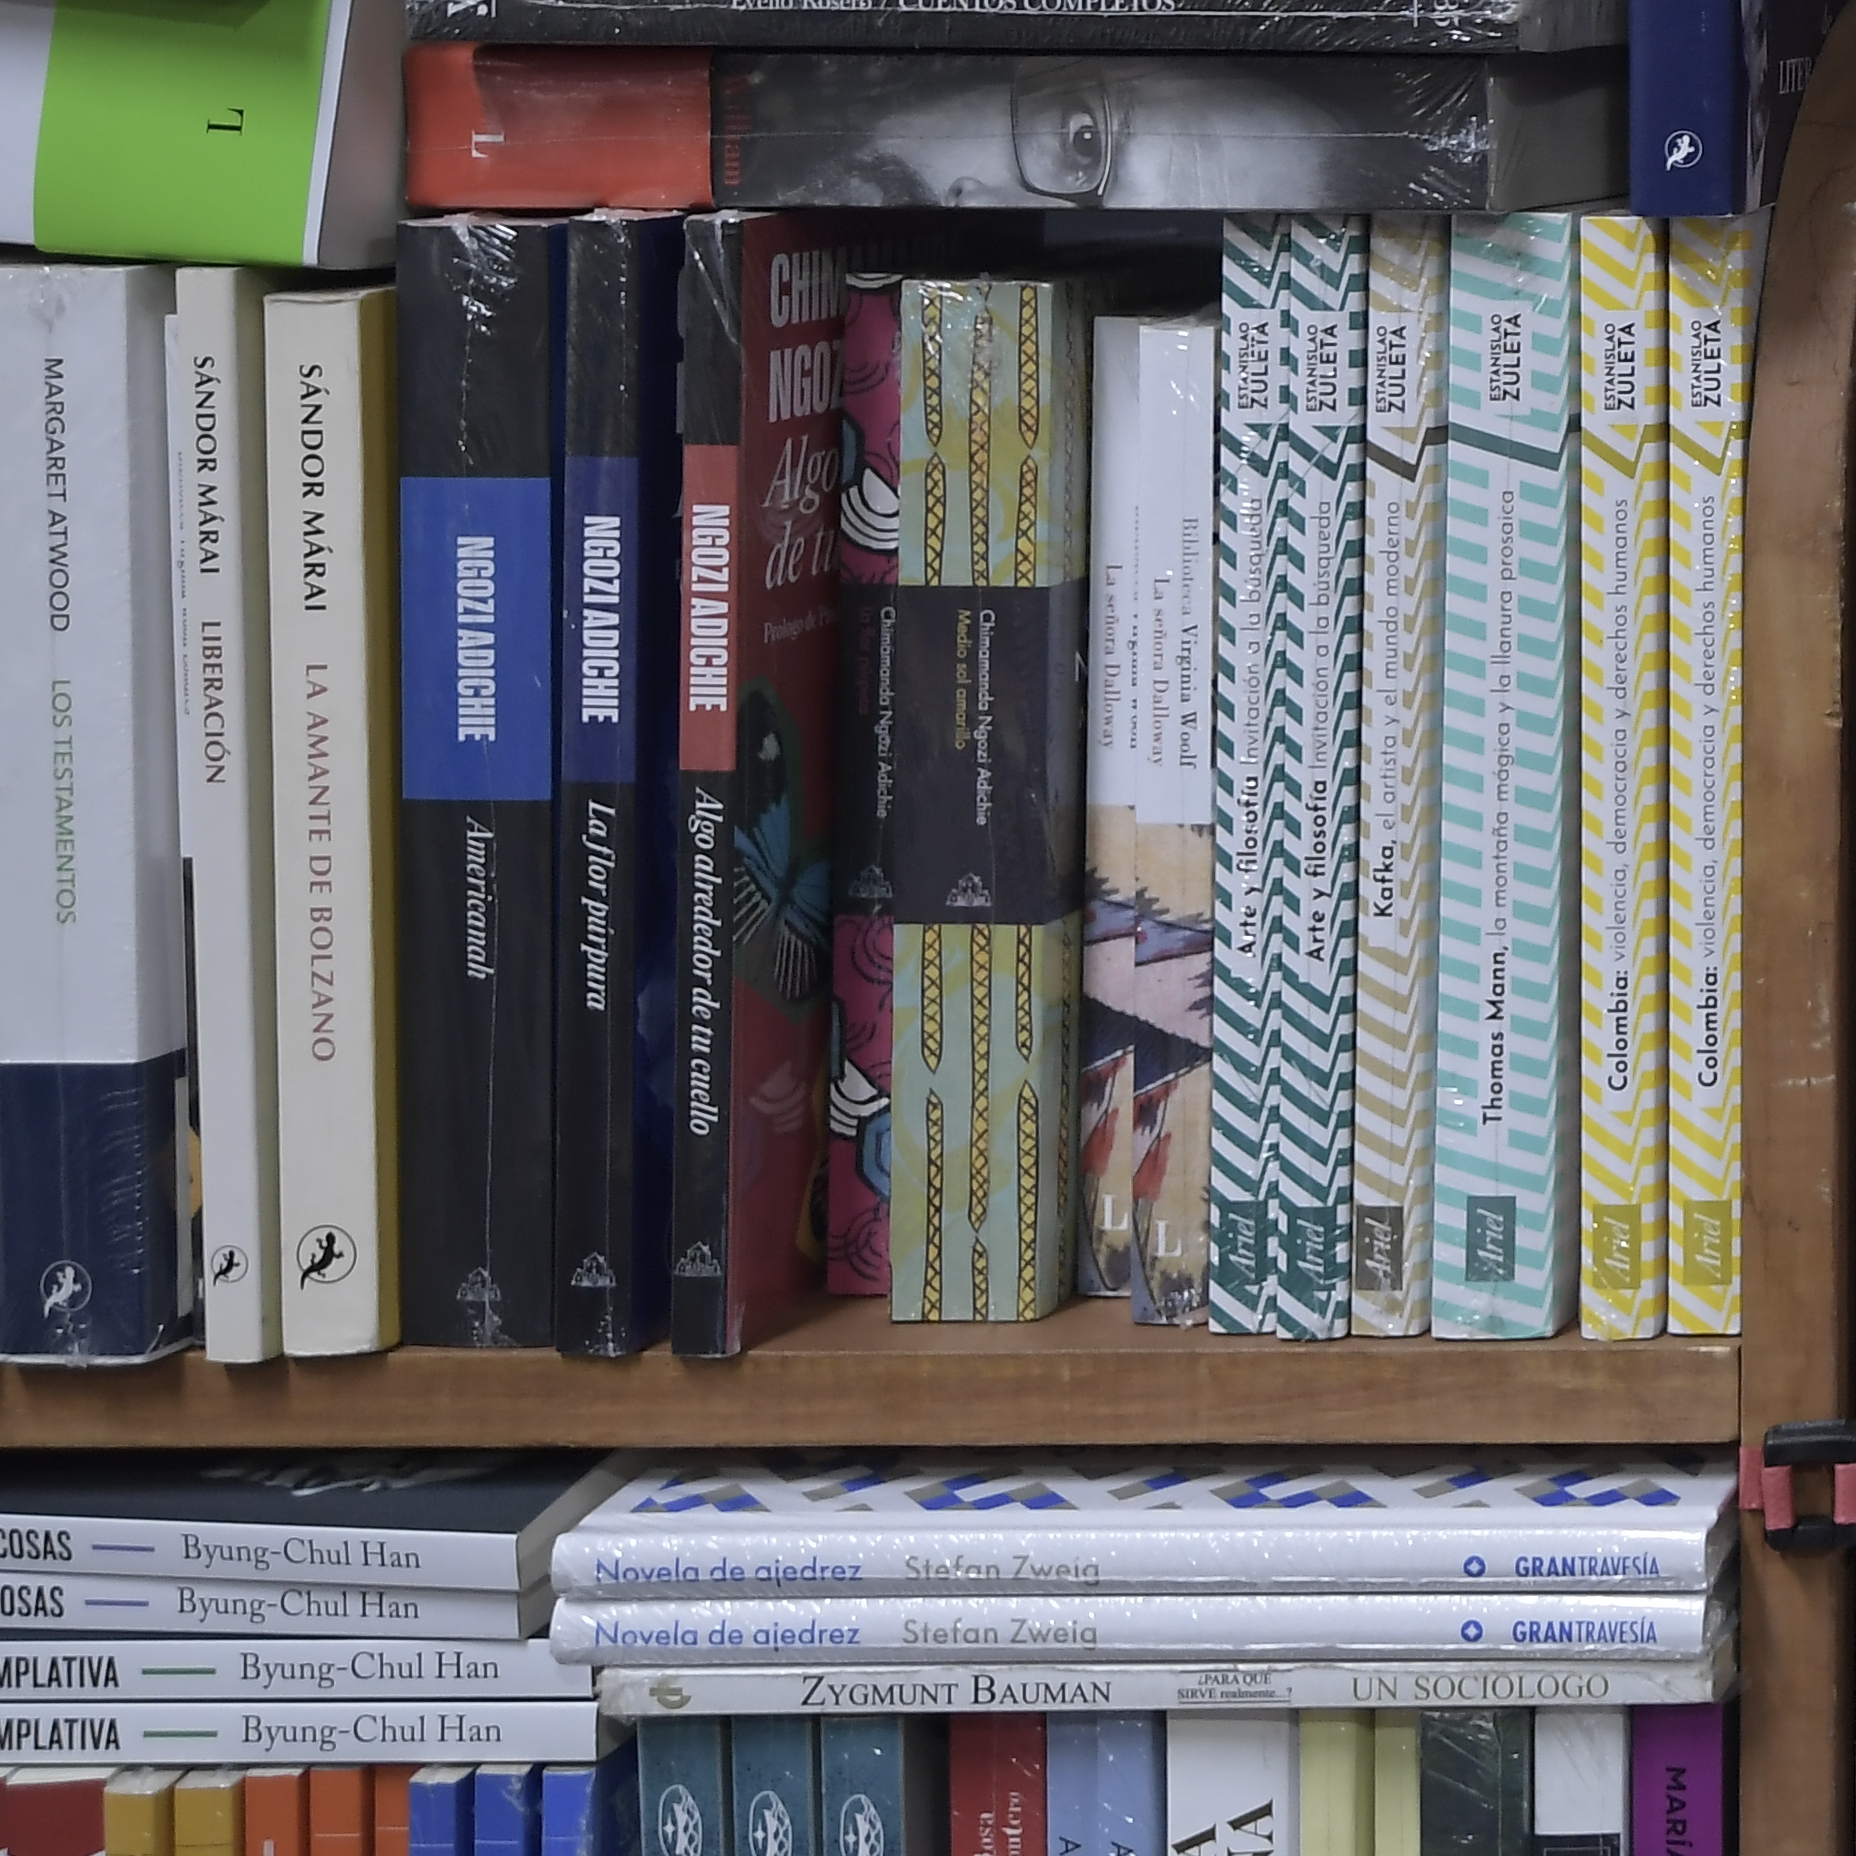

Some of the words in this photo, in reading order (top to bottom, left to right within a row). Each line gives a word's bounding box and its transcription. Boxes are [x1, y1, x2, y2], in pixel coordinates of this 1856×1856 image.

[1605, 323, 1615, 410] ESTANISLAO
[1618, 322, 1635, 410] ZULETA
[44, 357, 67, 501] MARGARET
[299, 364, 329, 498] SÁNDOR
[48, 509, 70, 632] ATWOOD
[302, 511, 334, 611] MÁRAI
[456, 536, 496, 622] NGOZI
[51, 679, 72, 726] LOS
[457, 630, 496, 742] ADICHIE
[54, 735, 77, 925] TESTAMENTOS
[466, 816, 495, 979] Americanah
[240, 1654, 424, 1688] Byung-Chul
[434, 1656, 500, 1680] Han
[595, 1619, 699, 1648] Novela
[709, 1620, 743, 1647] de
[752, 1619, 862, 1653] ajedrez
[903, 1618, 1005, 1646] Stefan
[1010, 1619, 1099, 1651] Zweig
[801, 1673, 959, 1707] ZYGMUNT
[970, 1672, 1111, 1705] BAUMAN
[1352, 1676, 1398, 1701] UN
